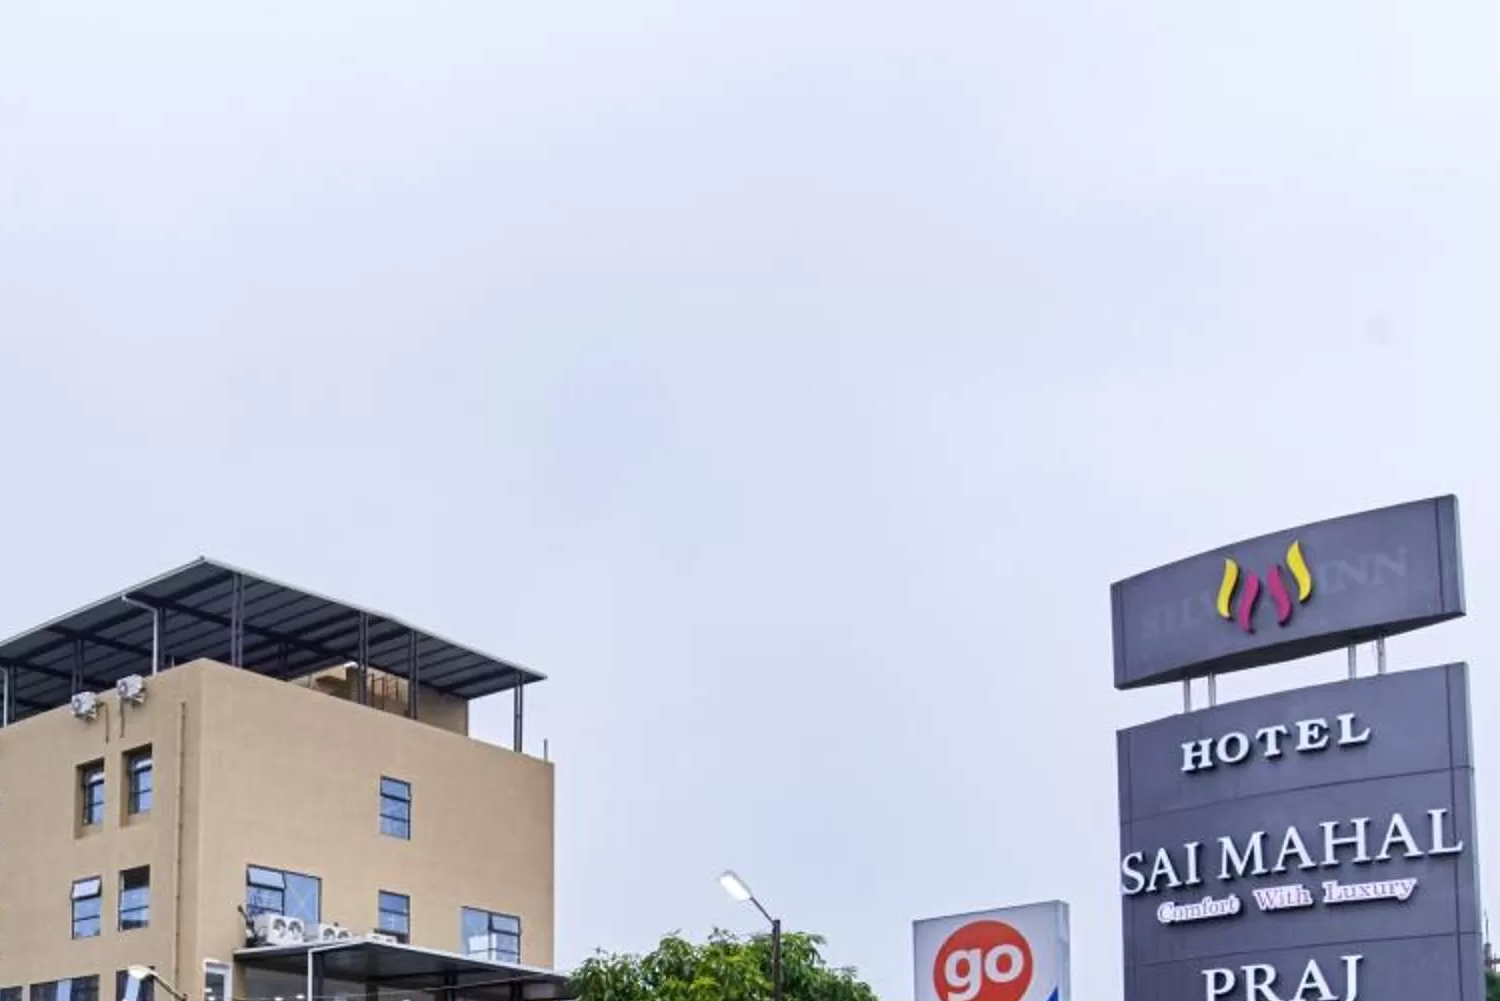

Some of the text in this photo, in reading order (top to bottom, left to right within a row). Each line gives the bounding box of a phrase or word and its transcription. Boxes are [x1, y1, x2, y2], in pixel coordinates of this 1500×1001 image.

[1181, 712, 1371, 772] HOTEL
[1122, 808, 1464, 896] SAI MAHAL
[1157, 878, 1417, 923] Comfort With Luxury
